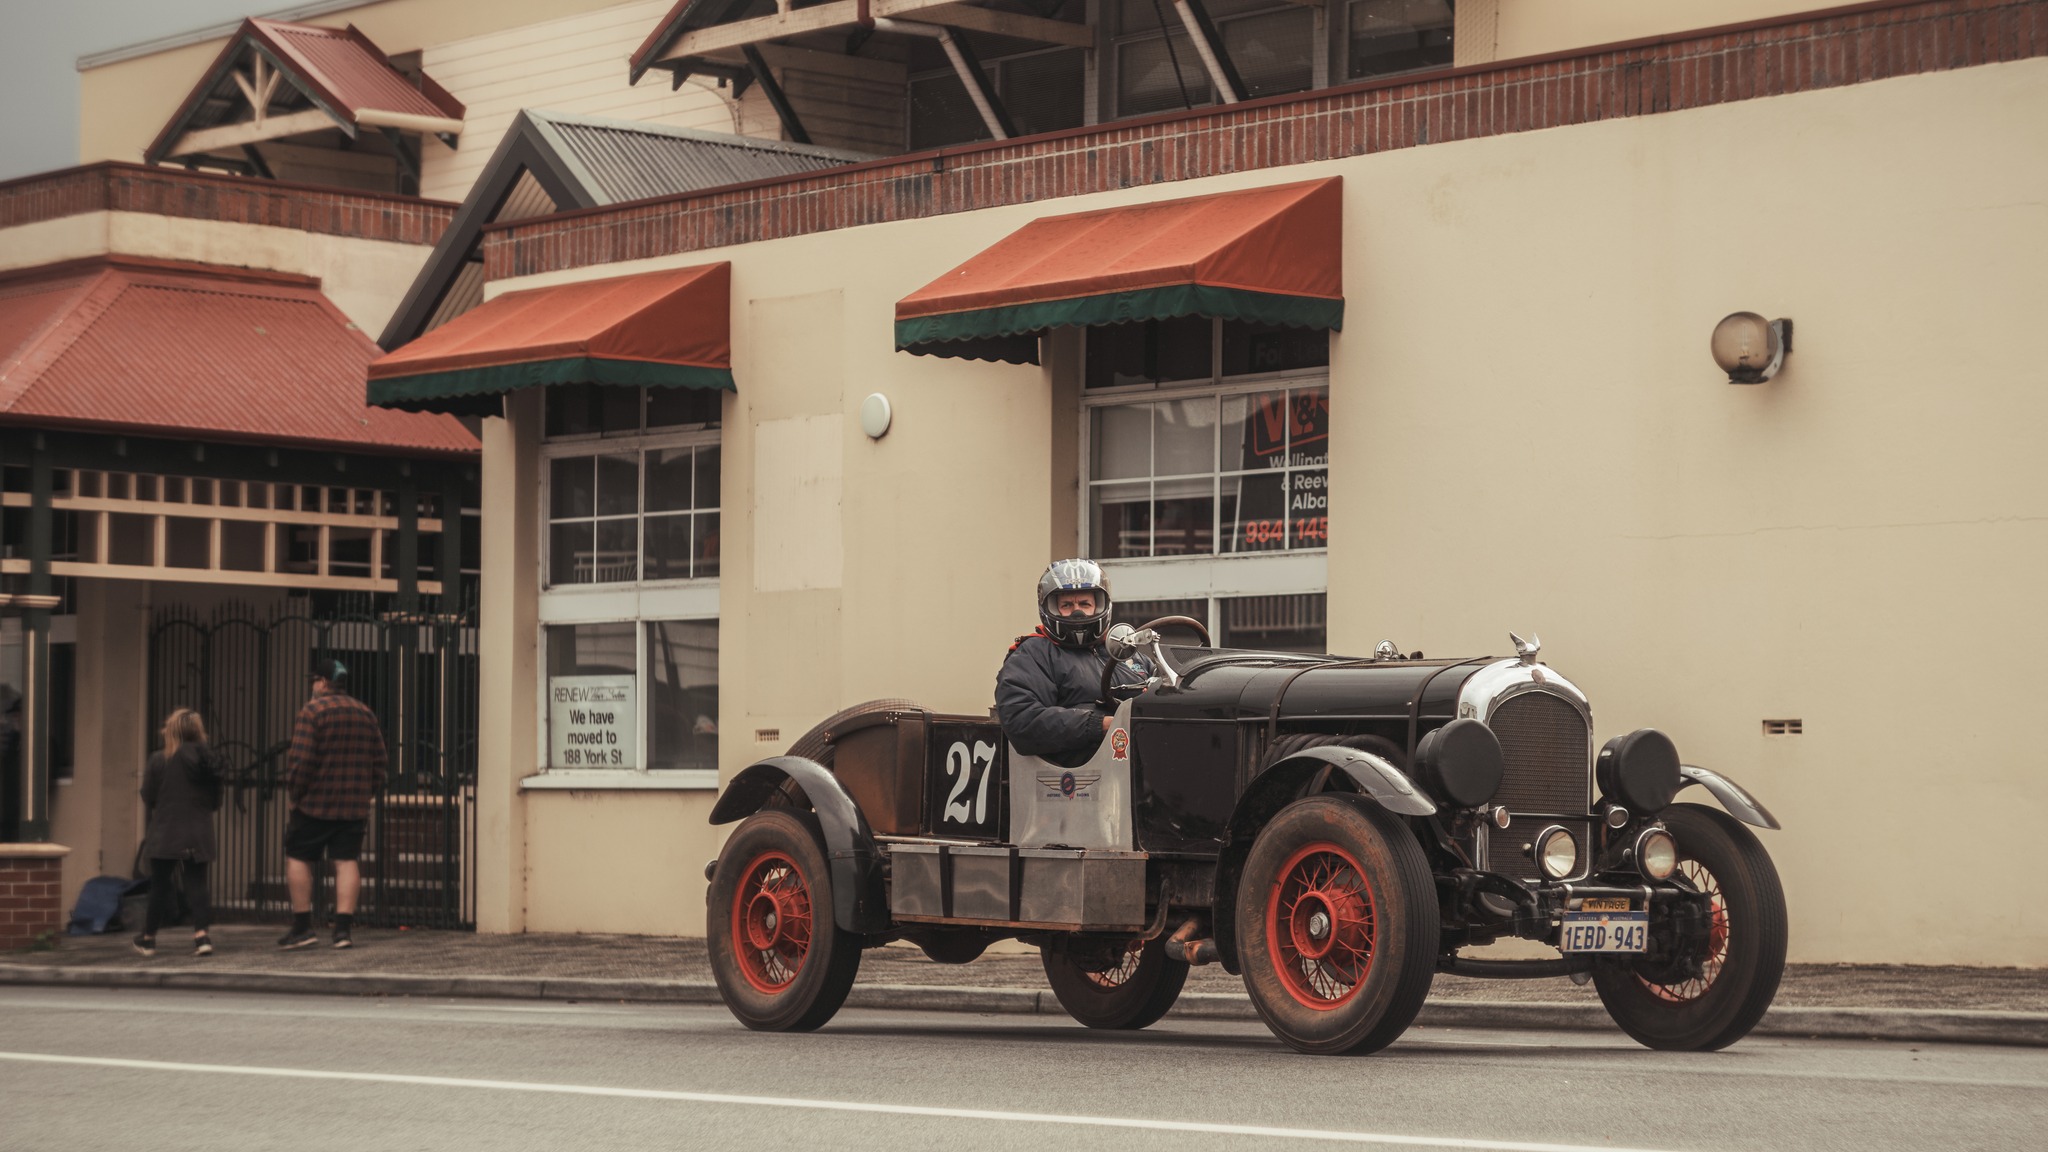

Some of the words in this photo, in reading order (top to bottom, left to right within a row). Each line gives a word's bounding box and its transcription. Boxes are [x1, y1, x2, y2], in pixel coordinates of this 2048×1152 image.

[1245, 519, 1292, 543] 984
[554, 686, 590, 703] RENEW
[570, 709, 586, 725] We
[589, 709, 614, 725] have
[567, 729, 603, 745] moved
[606, 730, 617, 745] to
[563, 749, 581, 765] 188
[584, 749, 607, 765] York
[611, 749, 623, 765] St
[943, 740, 996, 824] 27
[1588, 900, 1626, 909] VINTAGE
